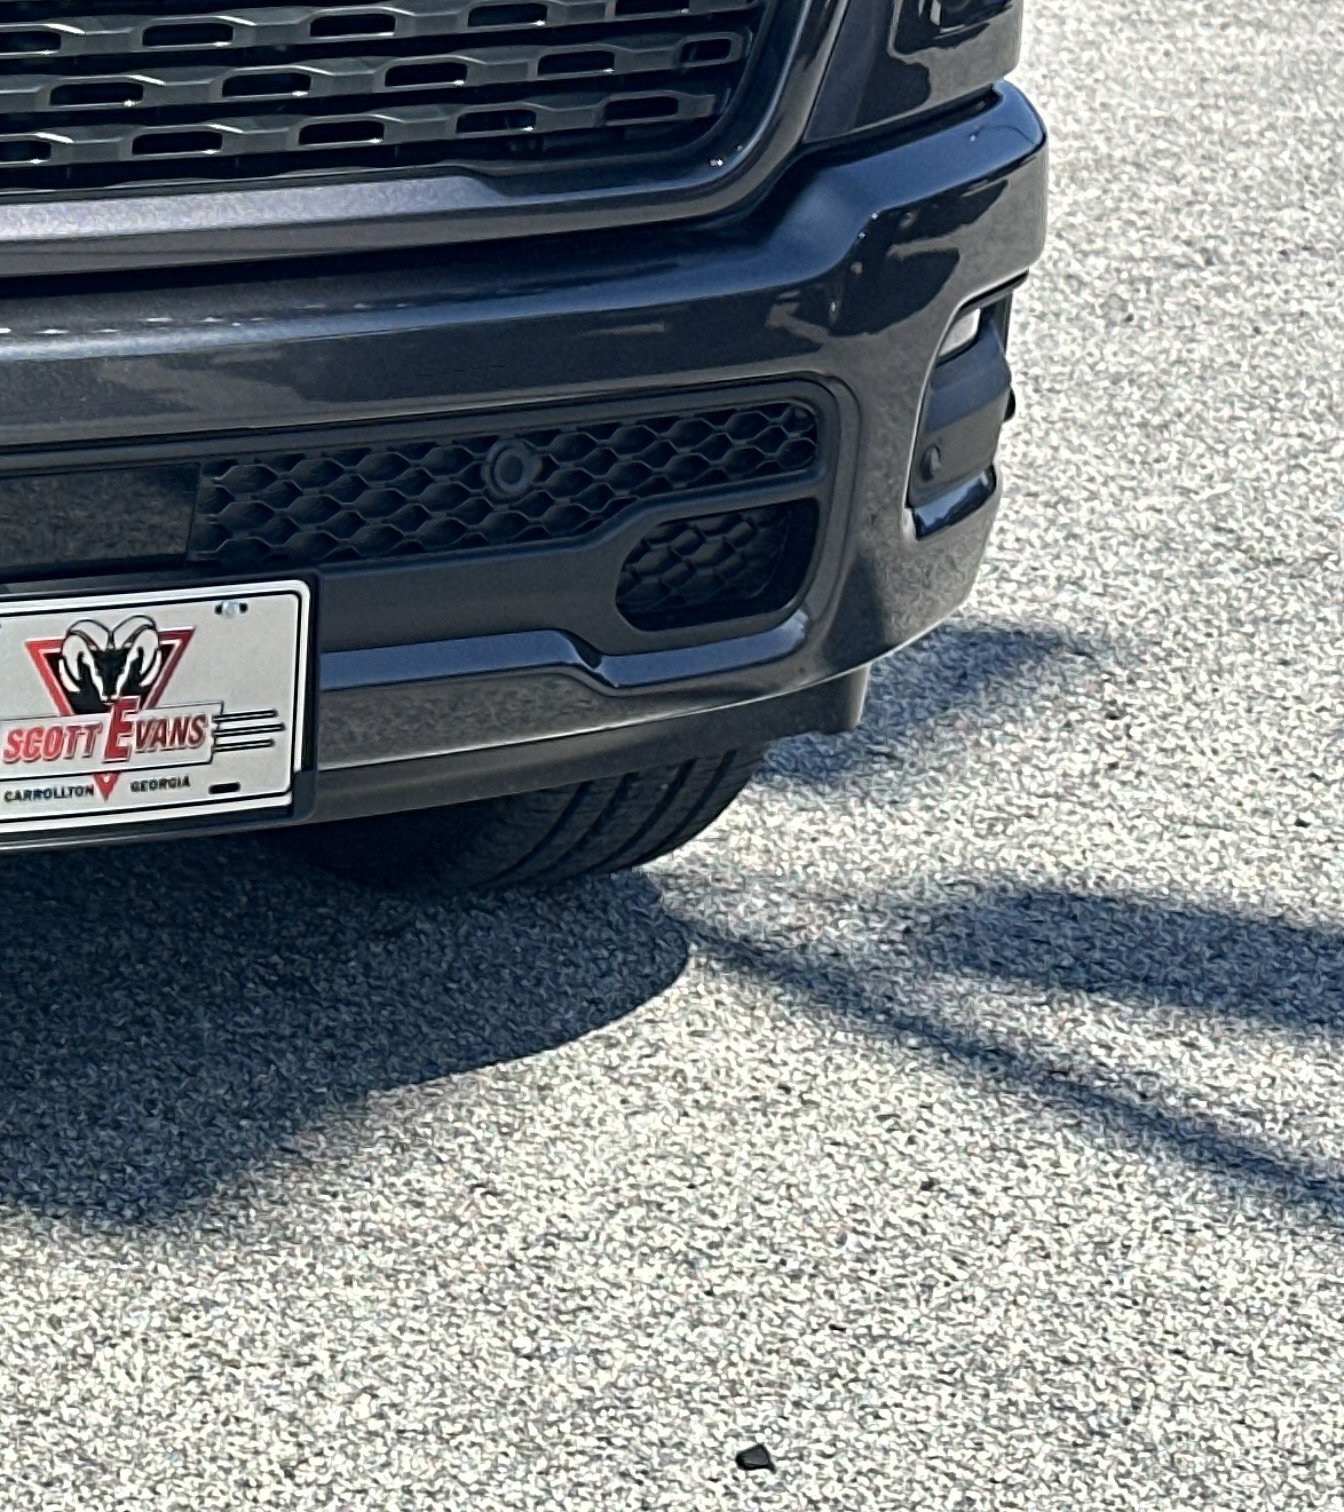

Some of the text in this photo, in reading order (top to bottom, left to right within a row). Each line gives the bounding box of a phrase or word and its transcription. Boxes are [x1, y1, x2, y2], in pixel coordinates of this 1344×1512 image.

[3, 695, 209, 765] SCOTT EVANS
[3, 773, 193, 803] CARROLLTON GEORGIA
